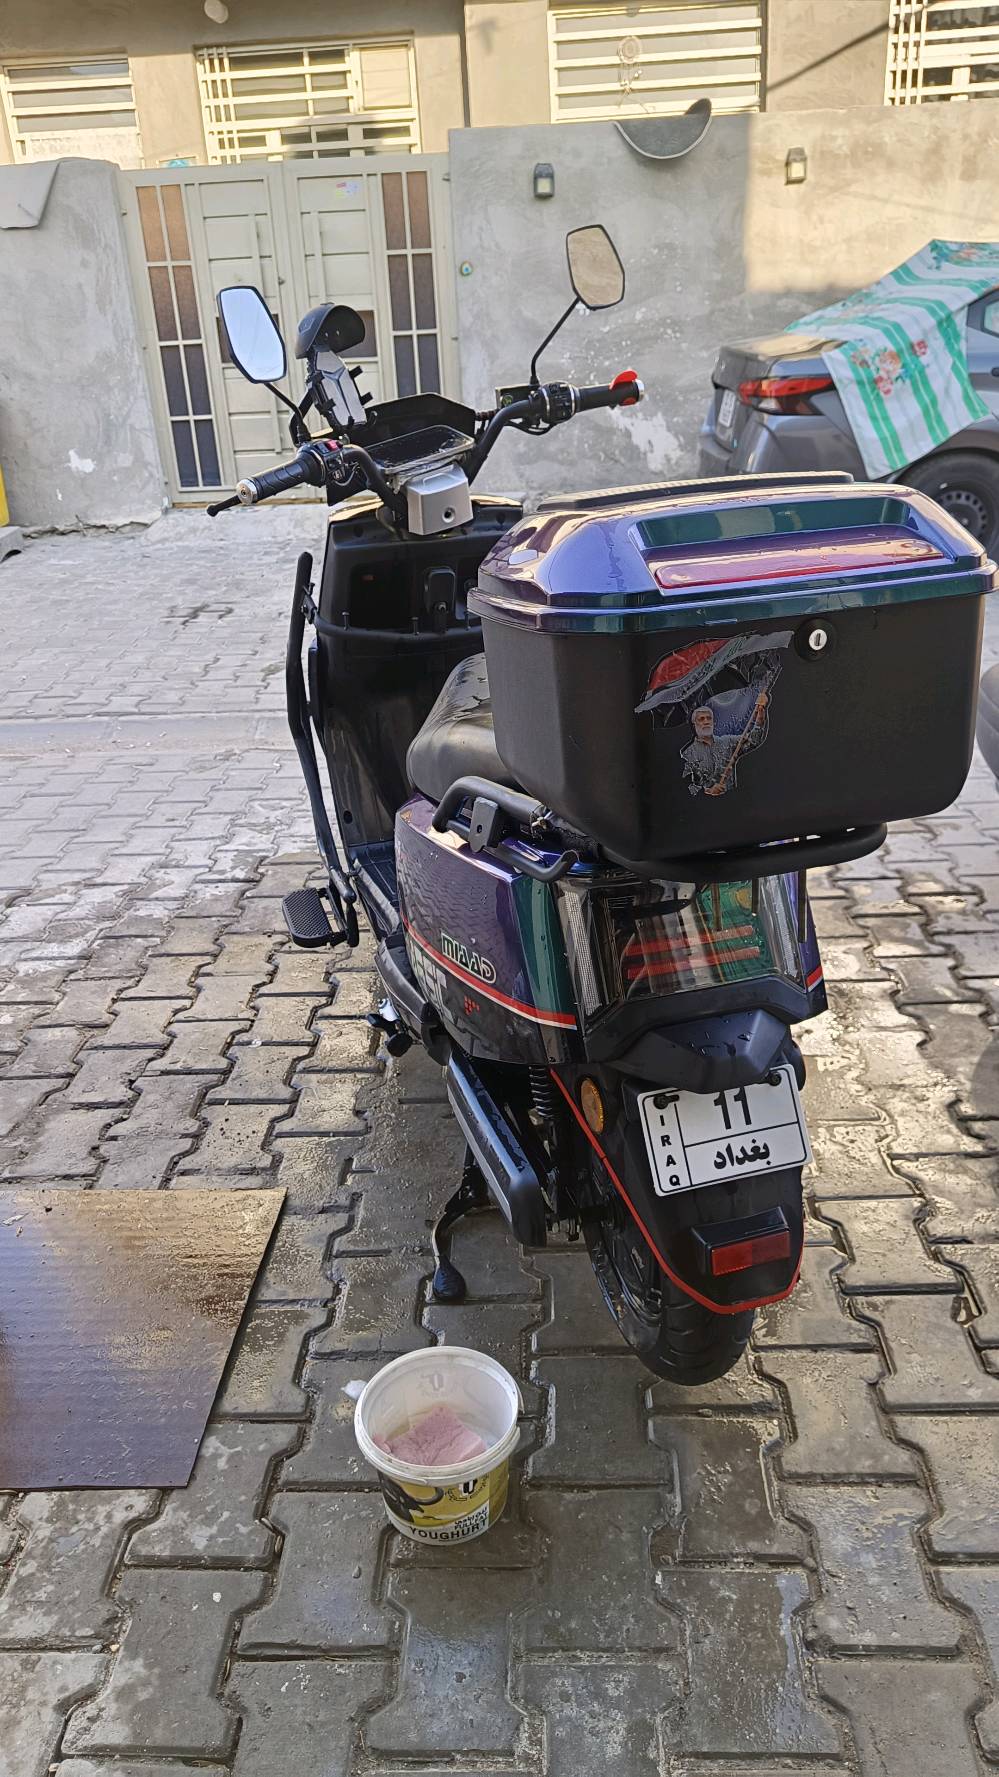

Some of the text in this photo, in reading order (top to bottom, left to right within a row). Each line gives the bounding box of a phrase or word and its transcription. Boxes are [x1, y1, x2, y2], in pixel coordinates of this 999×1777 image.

[659, 1115, 681, 1186] IRAQ
[713, 1139, 772, 1170] بغداد
[409, 1518, 488, 1540] YOUGHURT
